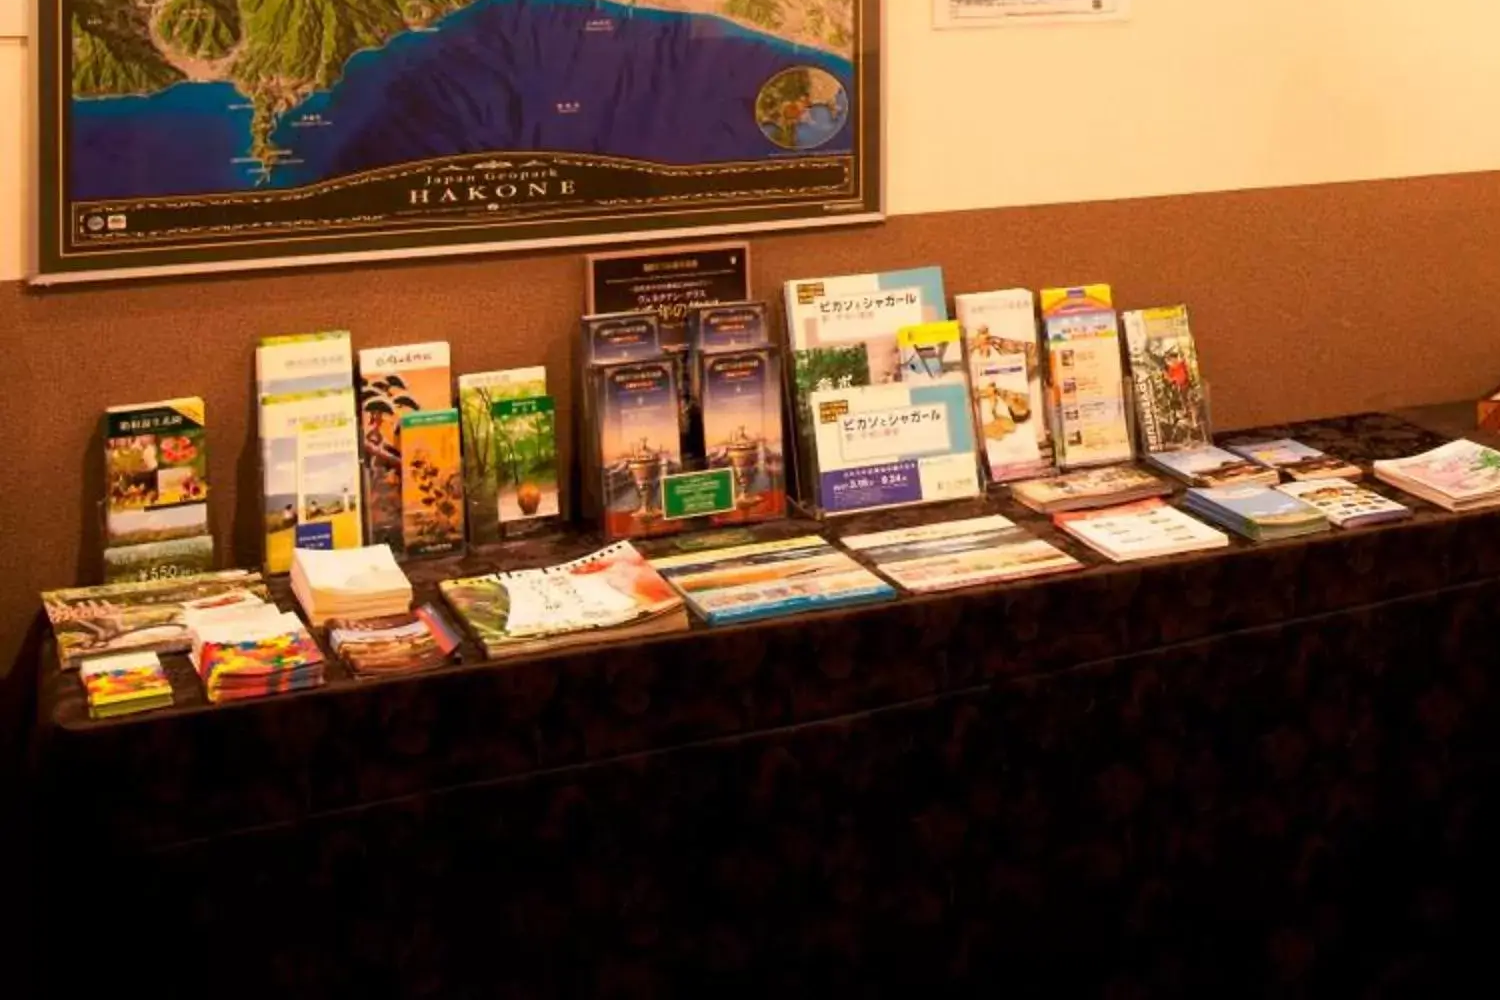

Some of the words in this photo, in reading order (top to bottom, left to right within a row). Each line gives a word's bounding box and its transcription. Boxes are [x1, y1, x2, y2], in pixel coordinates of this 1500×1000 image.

[424, 173, 476, 187] Japan
[484, 167, 559, 182] Geopark
[409, 179, 576, 205] HAKONE
[819, 293, 918, 313] ピカソとシャガール
[843, 409, 942, 432] ピカソとシャガール
